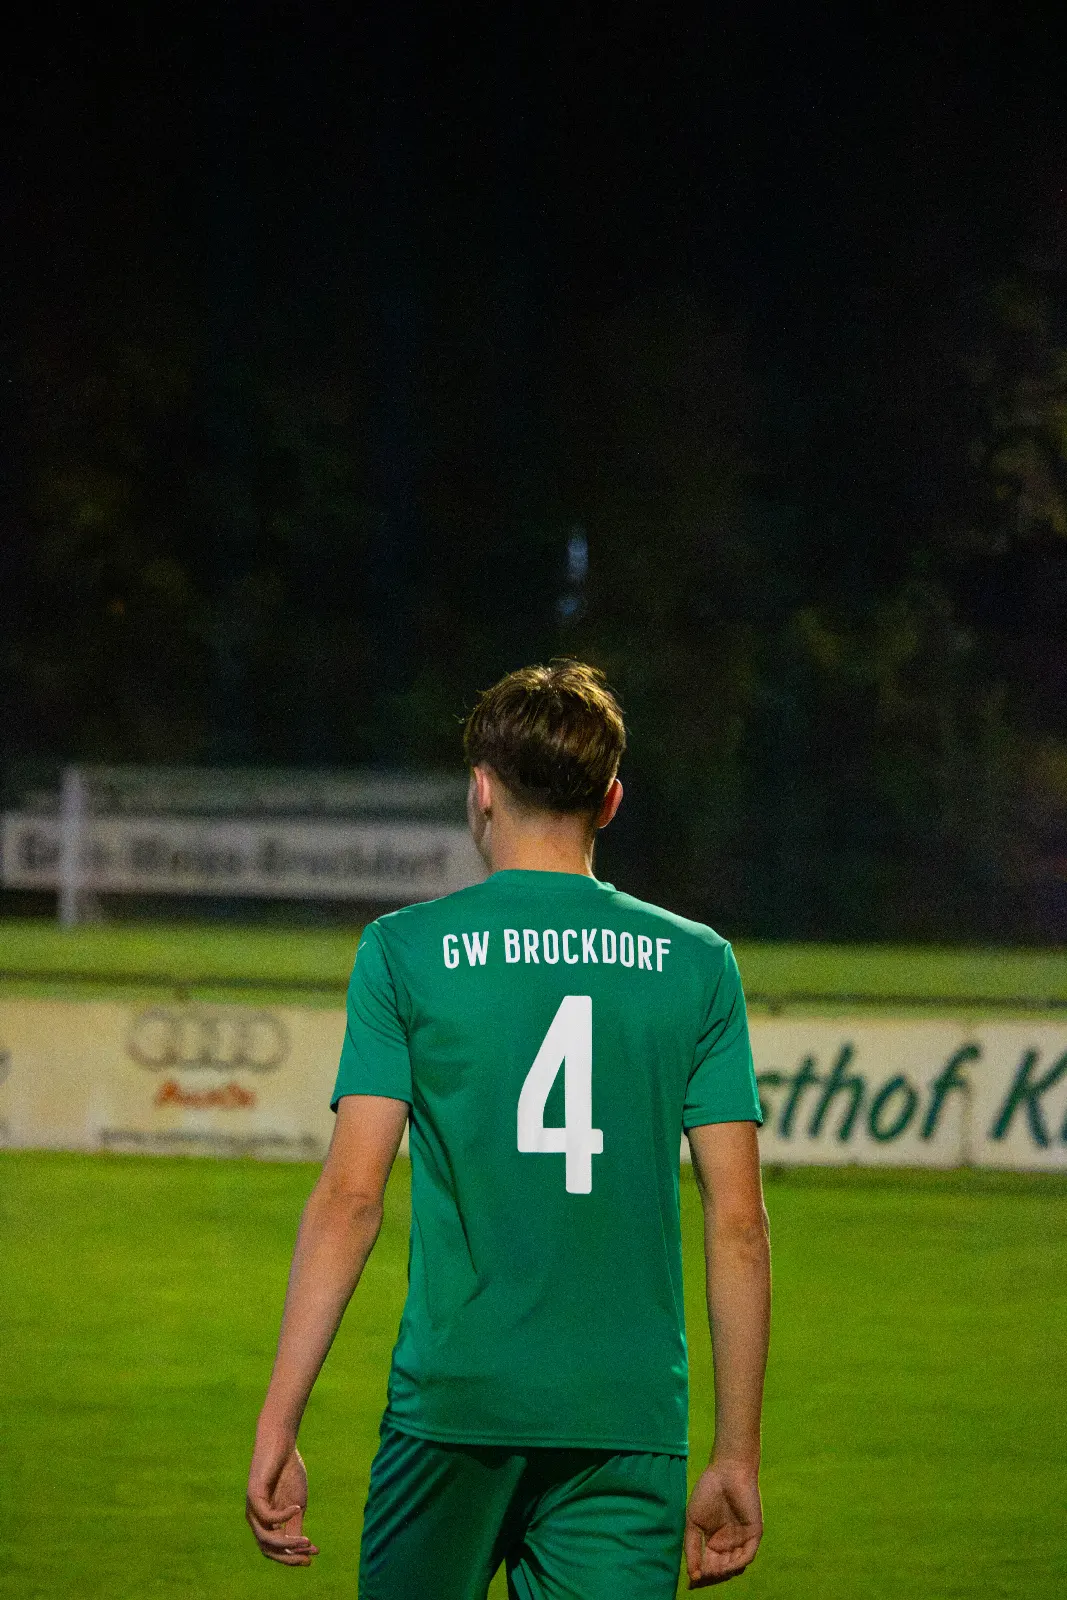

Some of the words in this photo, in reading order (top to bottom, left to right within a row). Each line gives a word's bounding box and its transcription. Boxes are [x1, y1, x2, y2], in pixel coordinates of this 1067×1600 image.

[442, 931, 490, 969] GW
[503, 928, 672, 972] BROCKDORF
[517, 995, 604, 1195] 4
